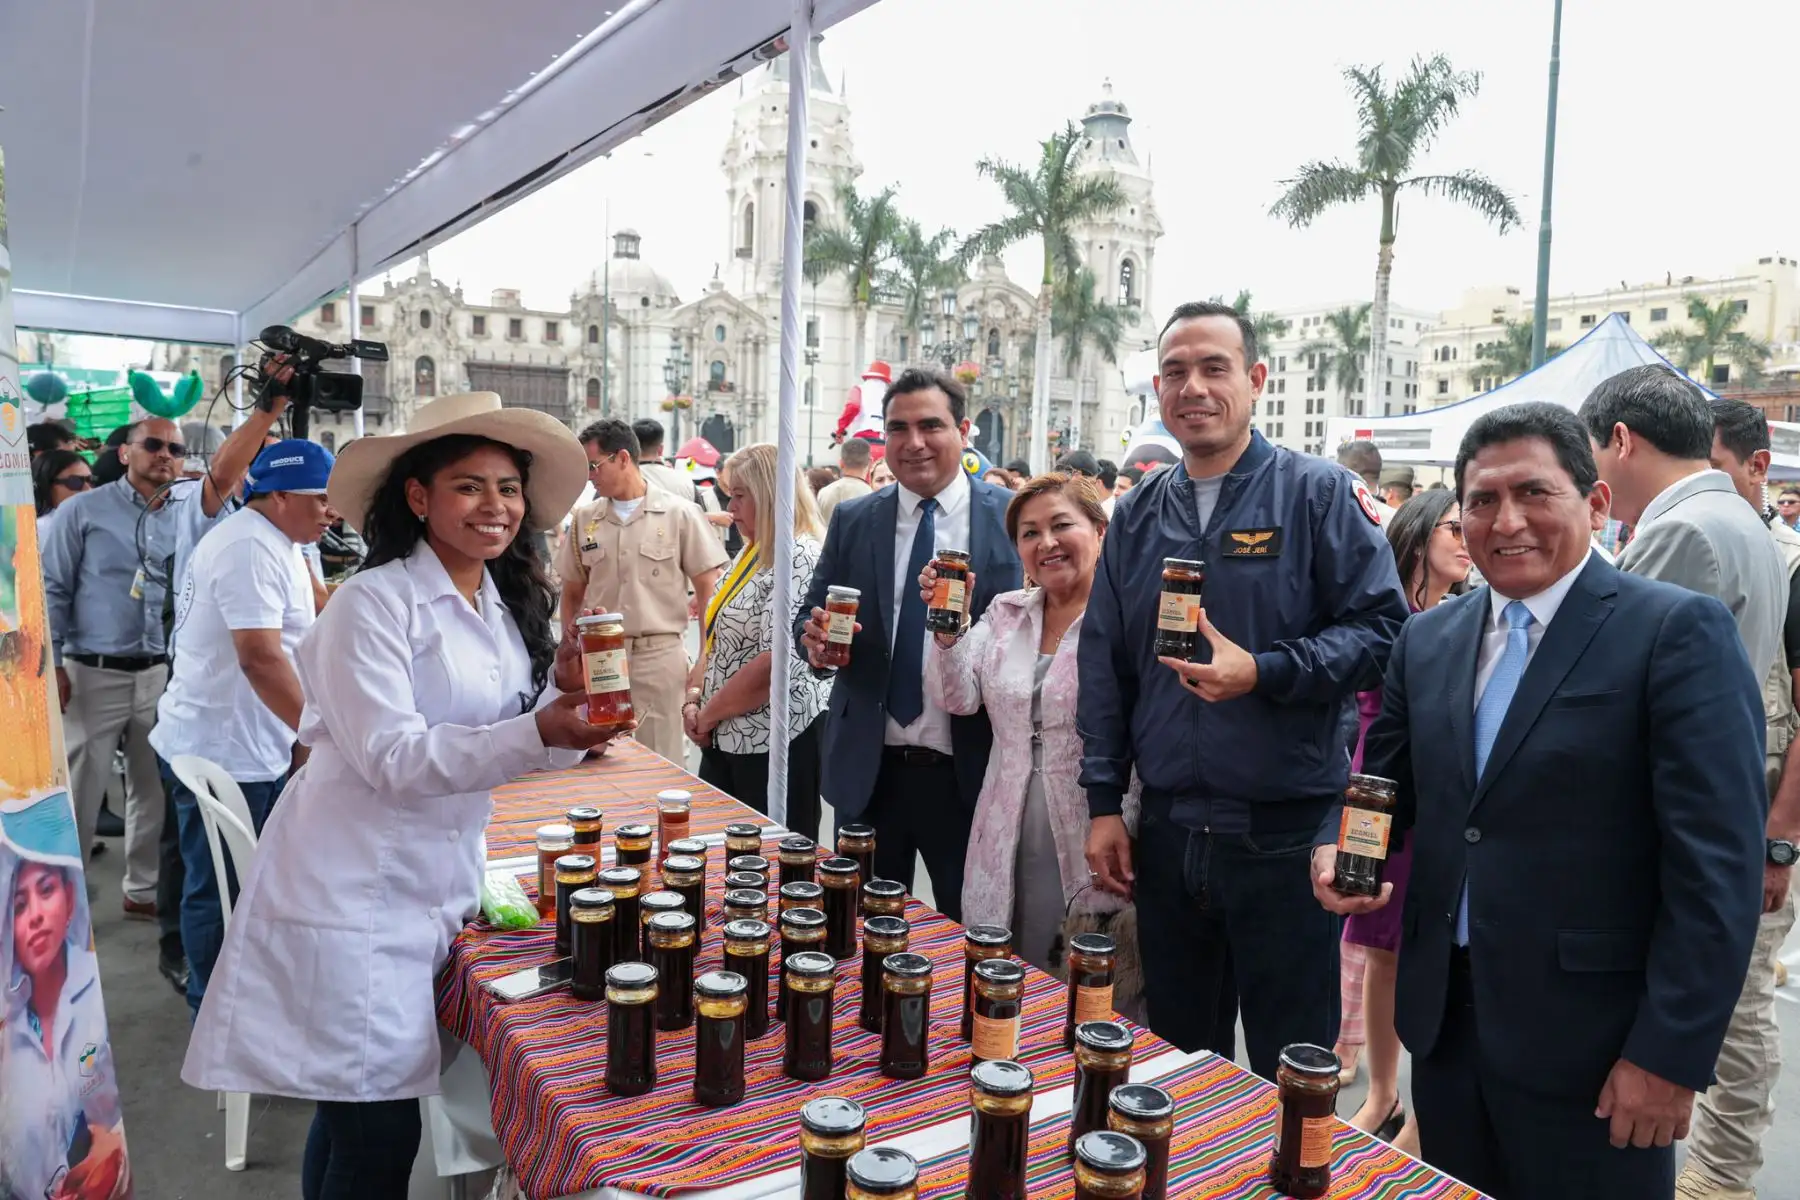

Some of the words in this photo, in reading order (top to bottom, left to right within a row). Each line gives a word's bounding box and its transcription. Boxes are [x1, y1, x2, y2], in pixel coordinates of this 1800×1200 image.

[270, 456, 305, 467] PRODUCE
[1233, 545, 1251, 554] JOSÉ
[1252, 545, 1269, 554] JERÍ
